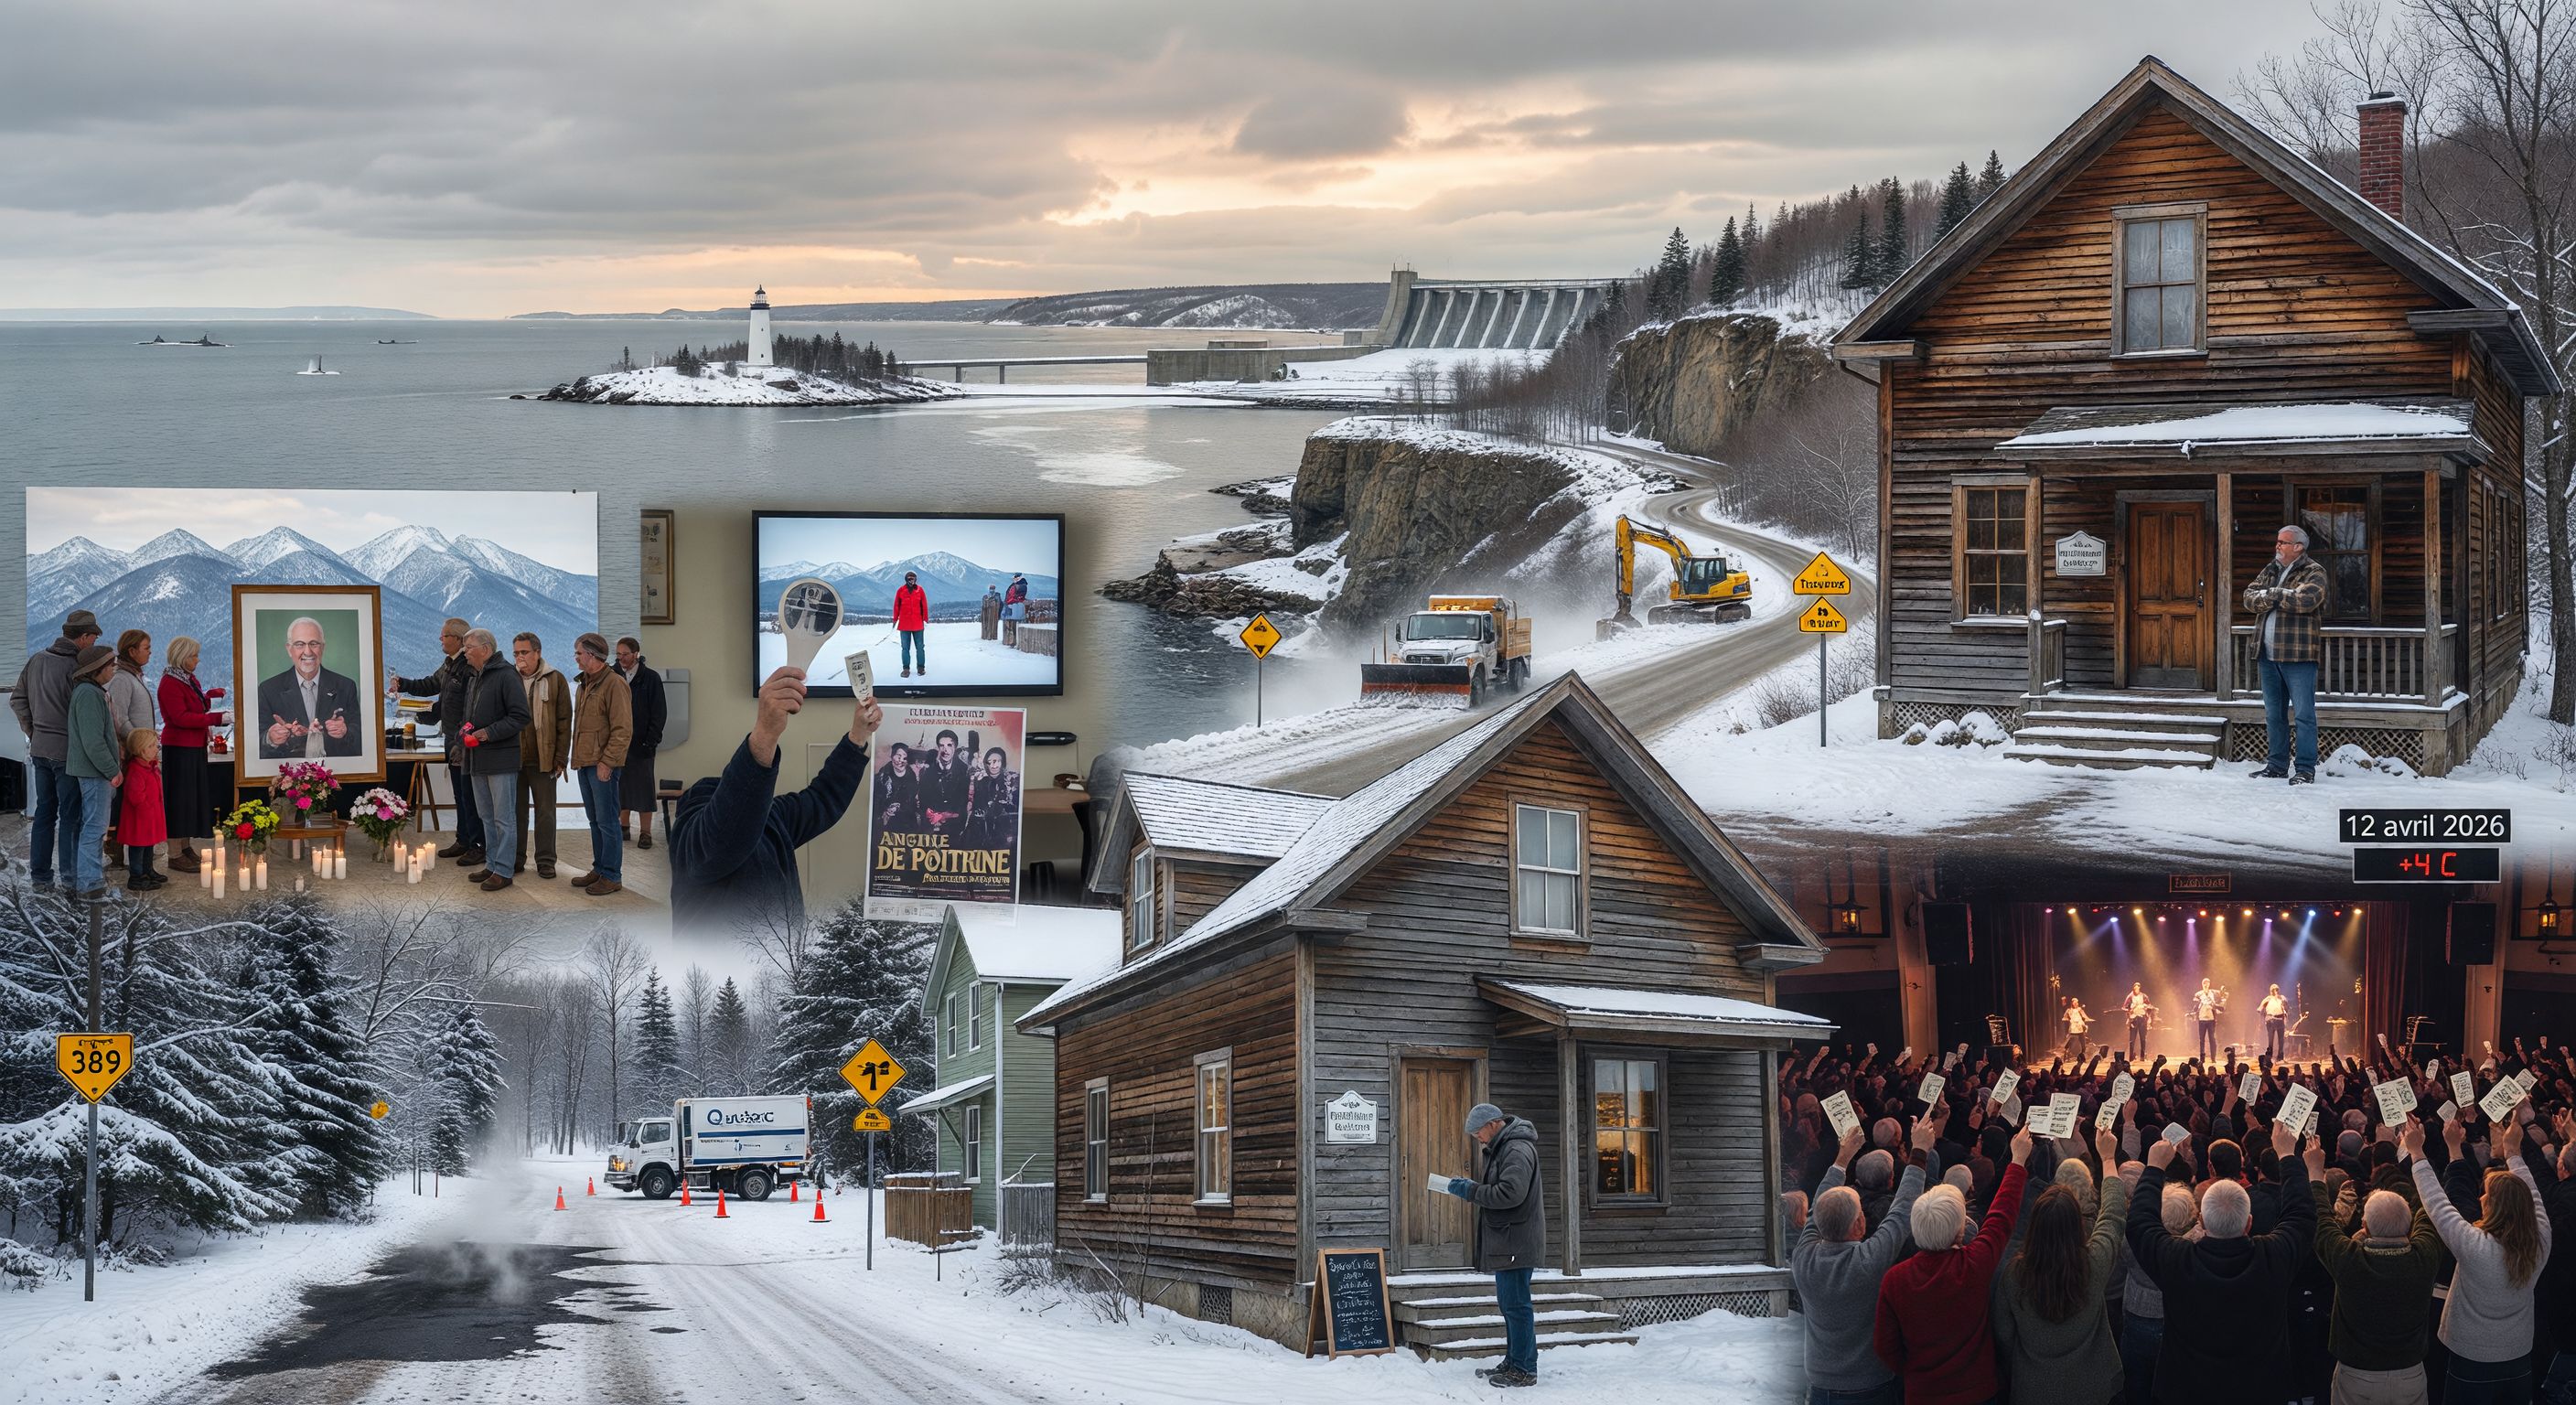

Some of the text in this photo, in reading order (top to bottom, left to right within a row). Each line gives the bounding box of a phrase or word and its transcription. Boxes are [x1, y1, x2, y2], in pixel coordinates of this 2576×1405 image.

[875, 845, 1011, 874] DE POITRINE
[71, 1049, 121, 1075] 389
